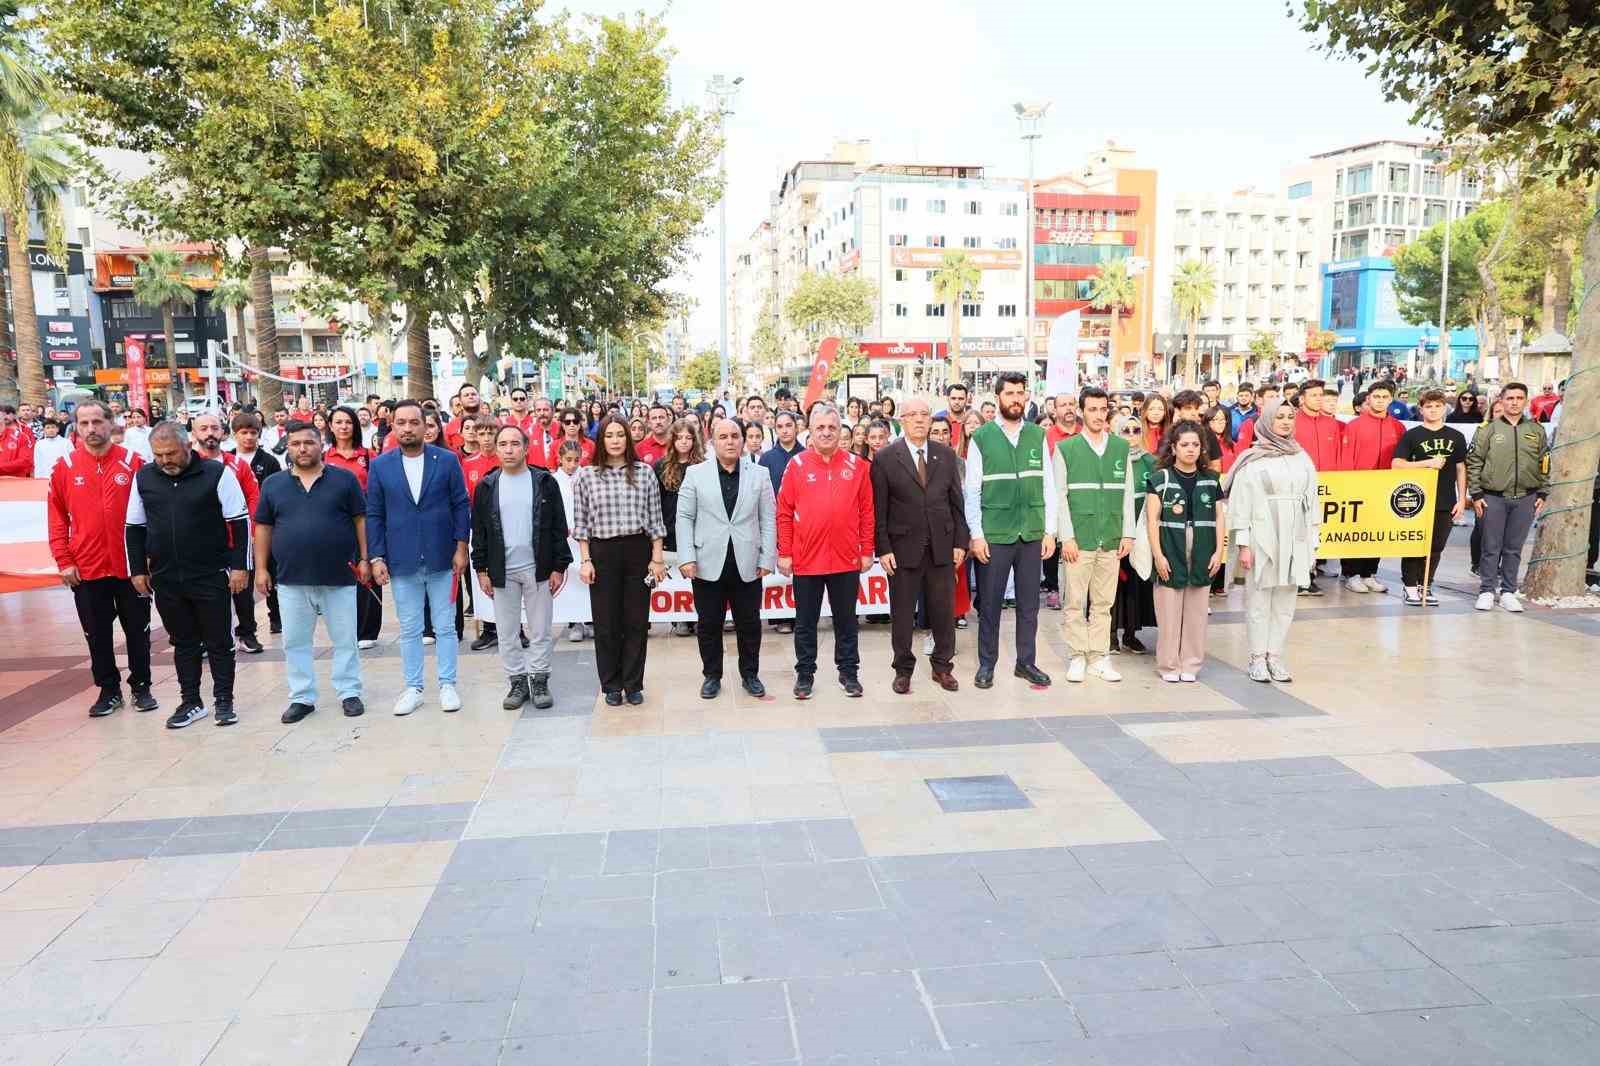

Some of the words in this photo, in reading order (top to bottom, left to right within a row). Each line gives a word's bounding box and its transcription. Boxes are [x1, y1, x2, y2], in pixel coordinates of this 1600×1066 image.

[1420, 439, 1454, 452] KHL
[1317, 485, 1332, 496] EL
[1325, 531, 1385, 542] ANADOLU
